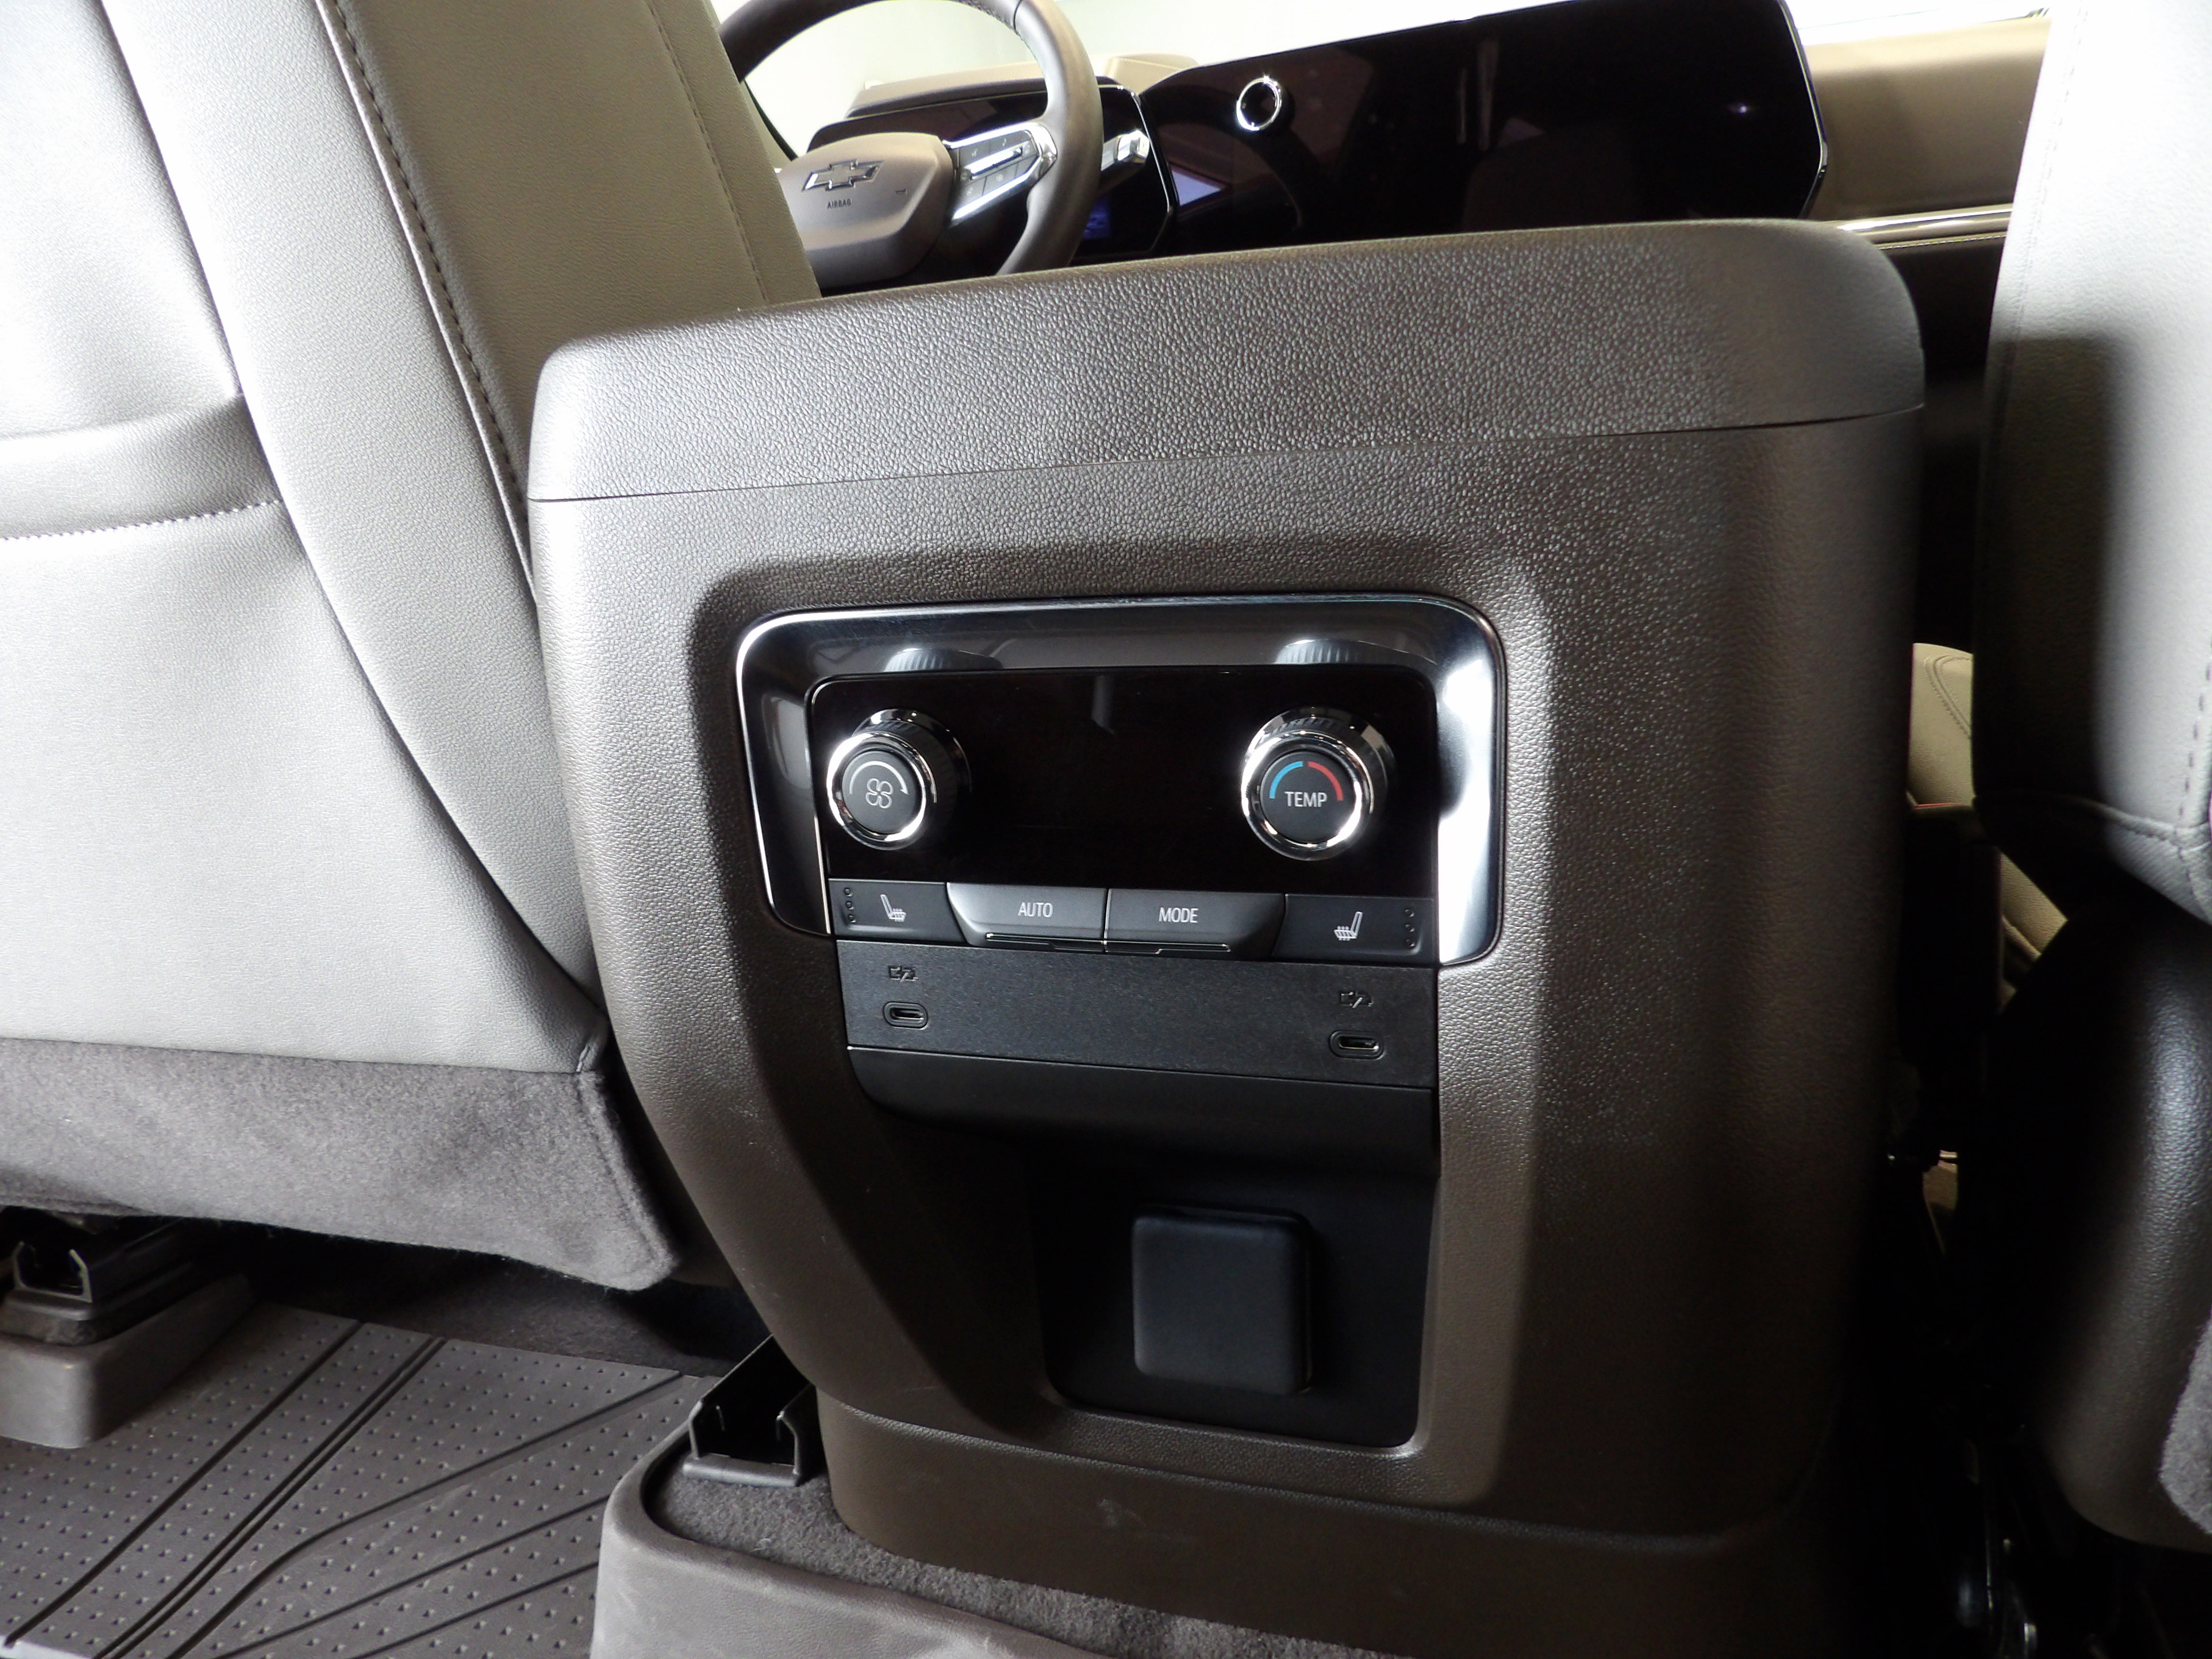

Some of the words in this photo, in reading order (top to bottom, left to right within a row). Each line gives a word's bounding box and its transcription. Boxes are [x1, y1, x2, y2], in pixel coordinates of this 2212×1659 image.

[827, 198, 851, 209] AIRBAG
[1284, 791, 1327, 807] TEMP
[1018, 902, 1053, 917] AUTO
[1158, 907, 1199, 923] MODE
